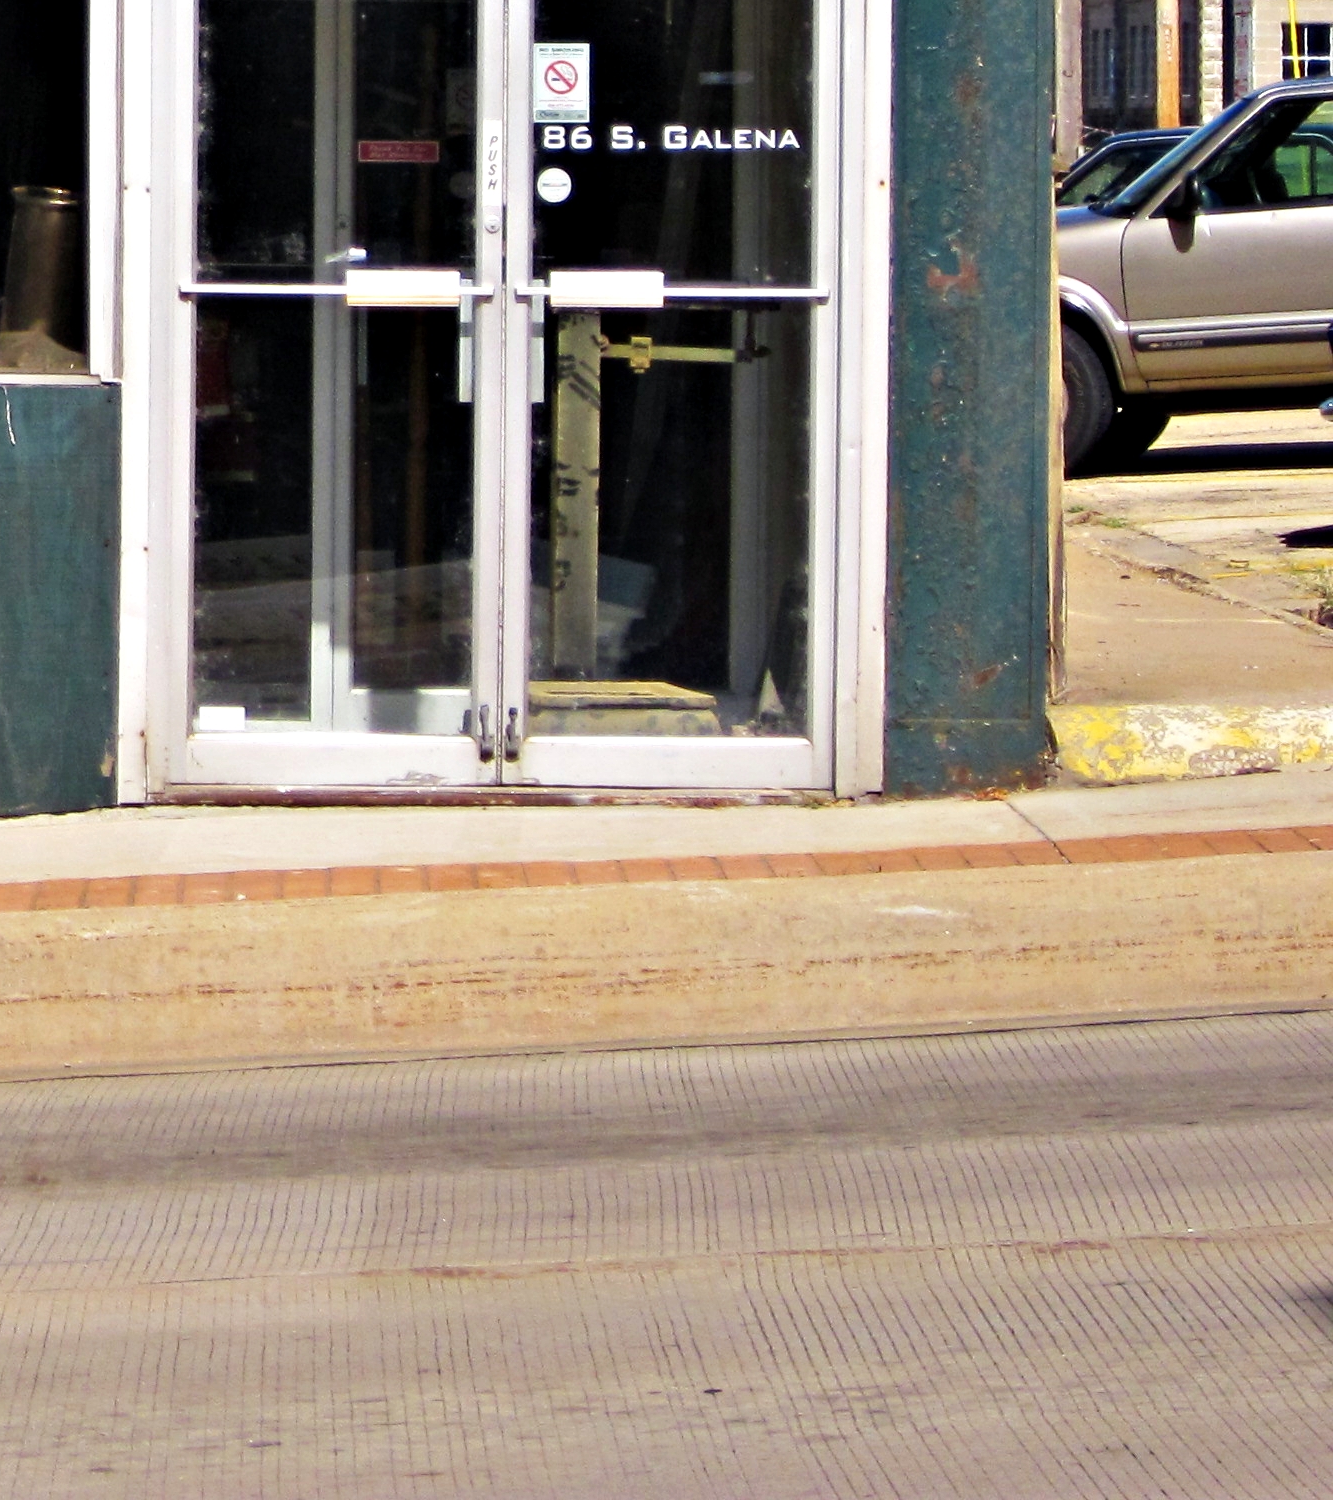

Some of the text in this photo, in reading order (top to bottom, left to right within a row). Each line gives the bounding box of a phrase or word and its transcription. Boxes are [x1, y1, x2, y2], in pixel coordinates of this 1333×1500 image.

[543, 125, 801, 150] 86 S. GALENA
[487, 135, 499, 190] PUSH
